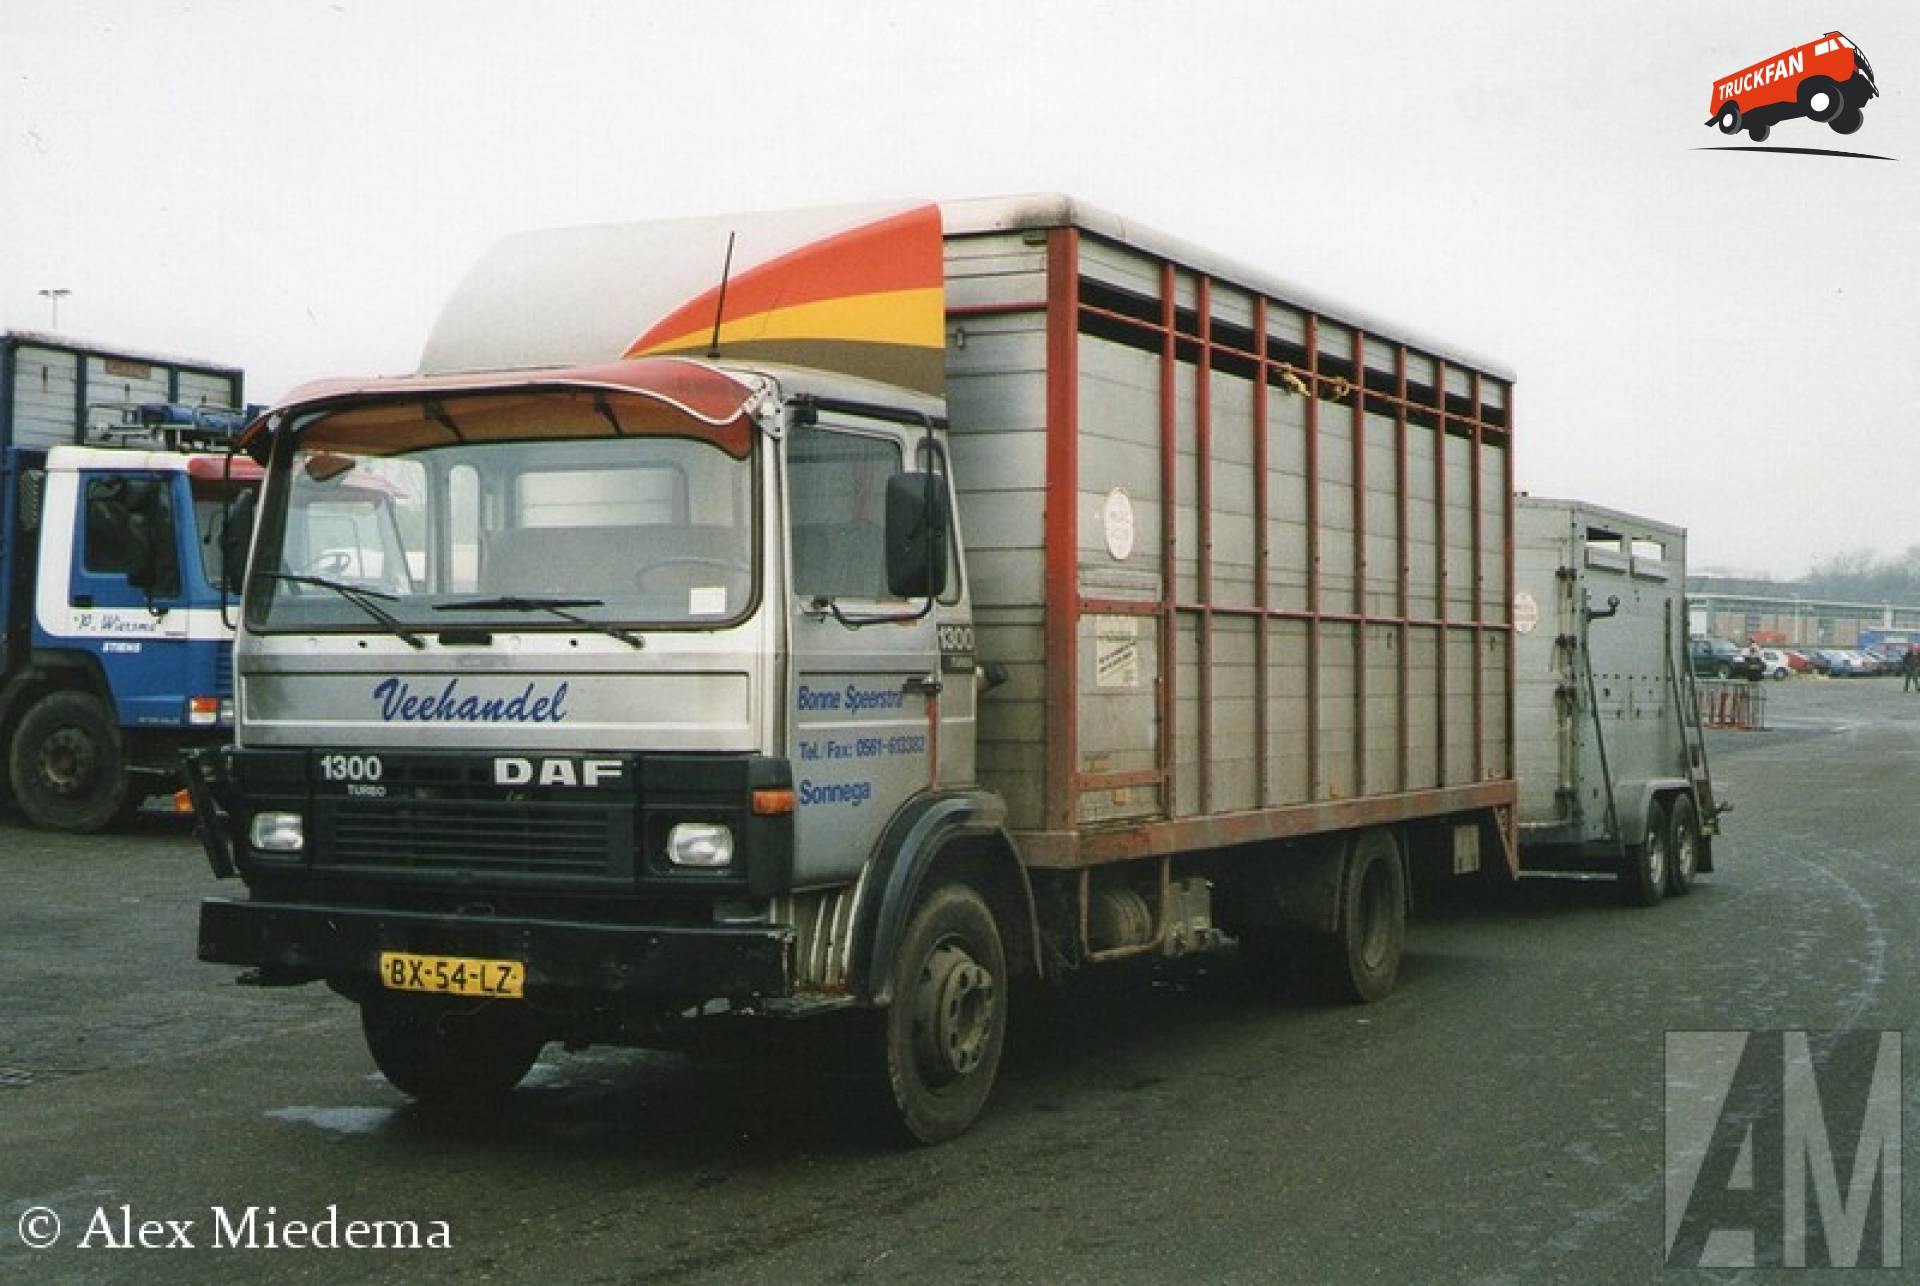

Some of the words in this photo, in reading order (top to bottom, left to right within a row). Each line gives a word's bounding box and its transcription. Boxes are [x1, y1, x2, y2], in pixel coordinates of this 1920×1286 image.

[373, 678, 569, 722] Veehandel
[798, 685, 841, 710] Bonne
[320, 755, 383, 781] 1300
[494, 757, 623, 787] DAF
[347, 783, 387, 798] TURBO
[798, 779, 872, 806] Sonnega
